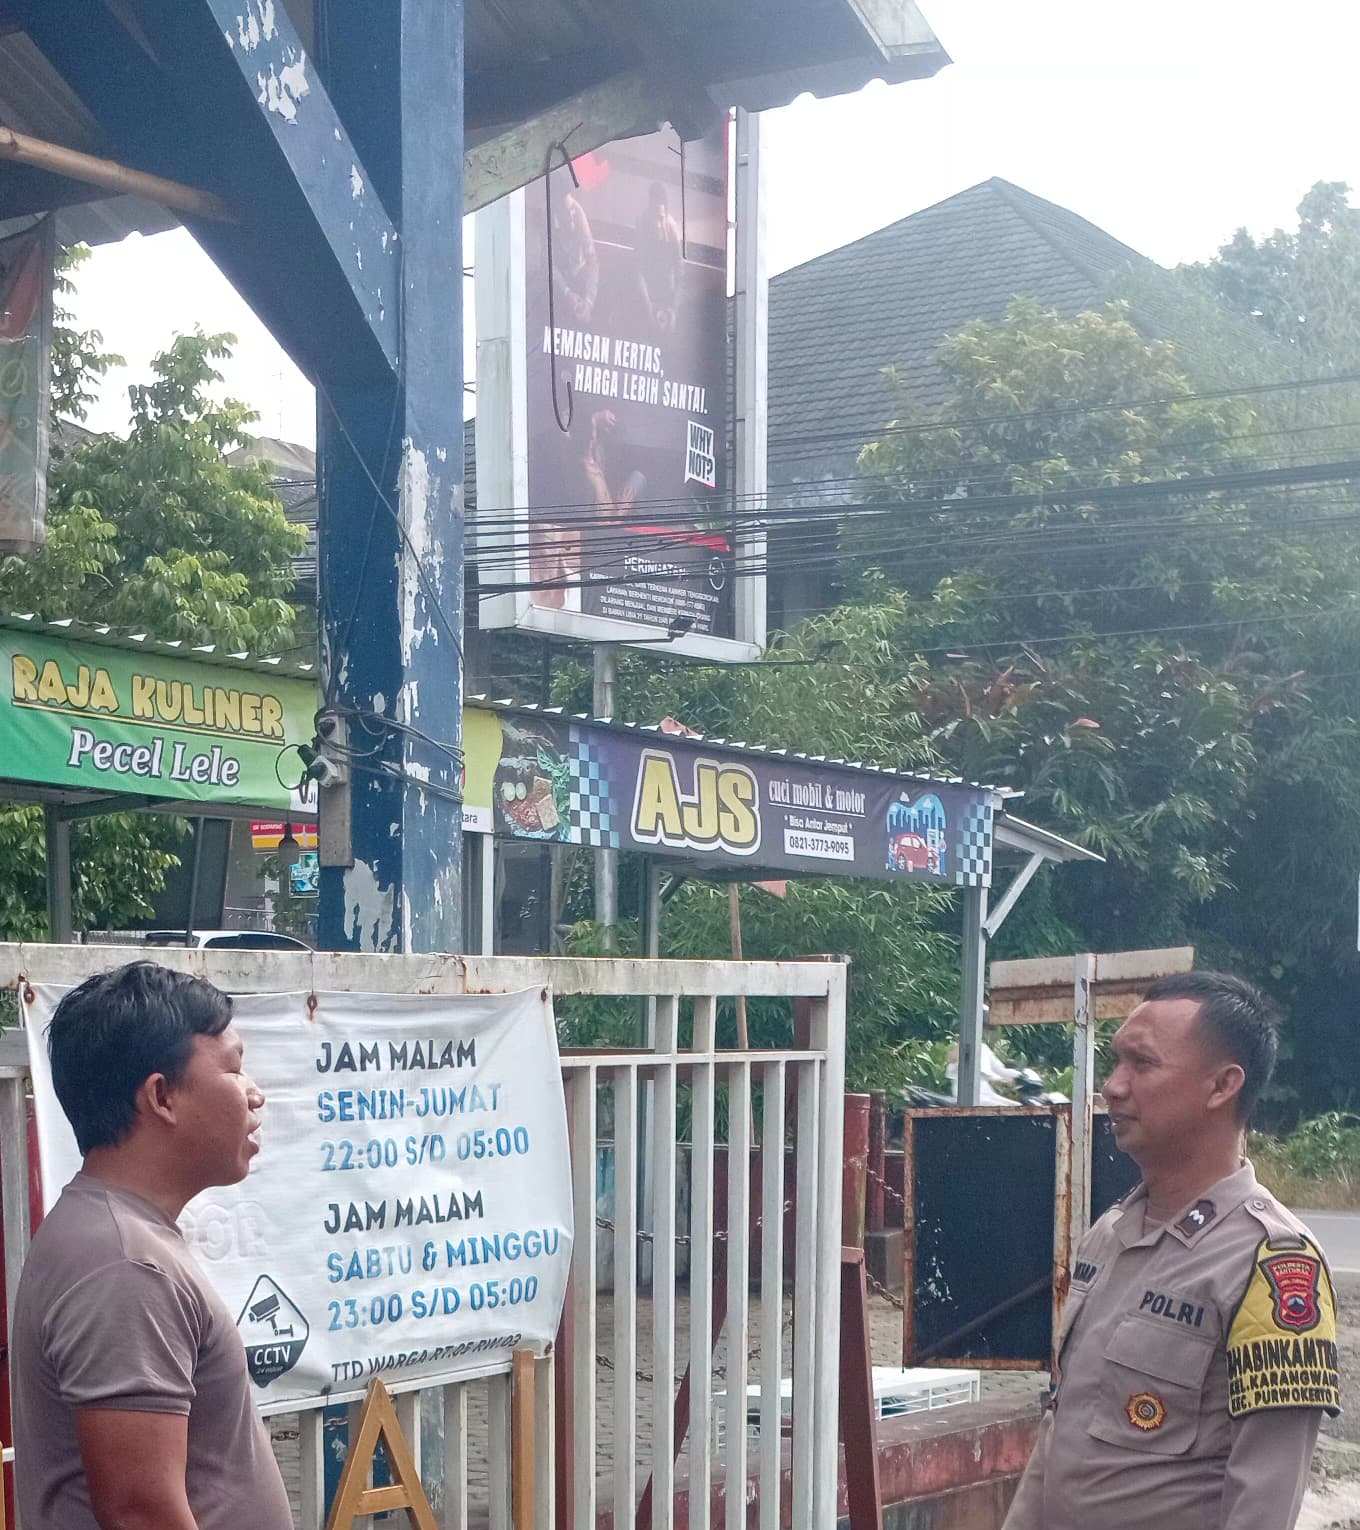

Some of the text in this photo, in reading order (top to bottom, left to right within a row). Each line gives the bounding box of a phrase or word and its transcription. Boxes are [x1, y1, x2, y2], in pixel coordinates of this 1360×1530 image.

[614, 339, 664, 377] KERTAS,
[574, 364, 708, 414] HARGA LEBIH SANTAI.
[690, 423, 712, 454] WHY
[689, 450, 713, 481] NOT?
[11, 654, 285, 738] RAJA KULINER
[67, 726, 240, 787] Pecel Lele
[630, 748, 761, 855] AJS
[769, 779, 865, 813] cuci mobil & motor
[316, 1038, 477, 1074] JAM MALAM
[317, 1083, 502, 1123] SENIN-JUMAT
[320, 1125, 529, 1172] 22:00 S/D 05:00
[323, 1190, 485, 1235] JAM MALAM
[327, 1227, 560, 1284] SABTU & MINGGU
[327, 1275, 539, 1332] 23:00 S/D 05:00
[1139, 1290, 1205, 1328] POLRI
[254, 1345, 291, 1365] CCTV
[331, 1360, 363, 1382] TTD
[368, 1350, 427, 1375] WARGA
